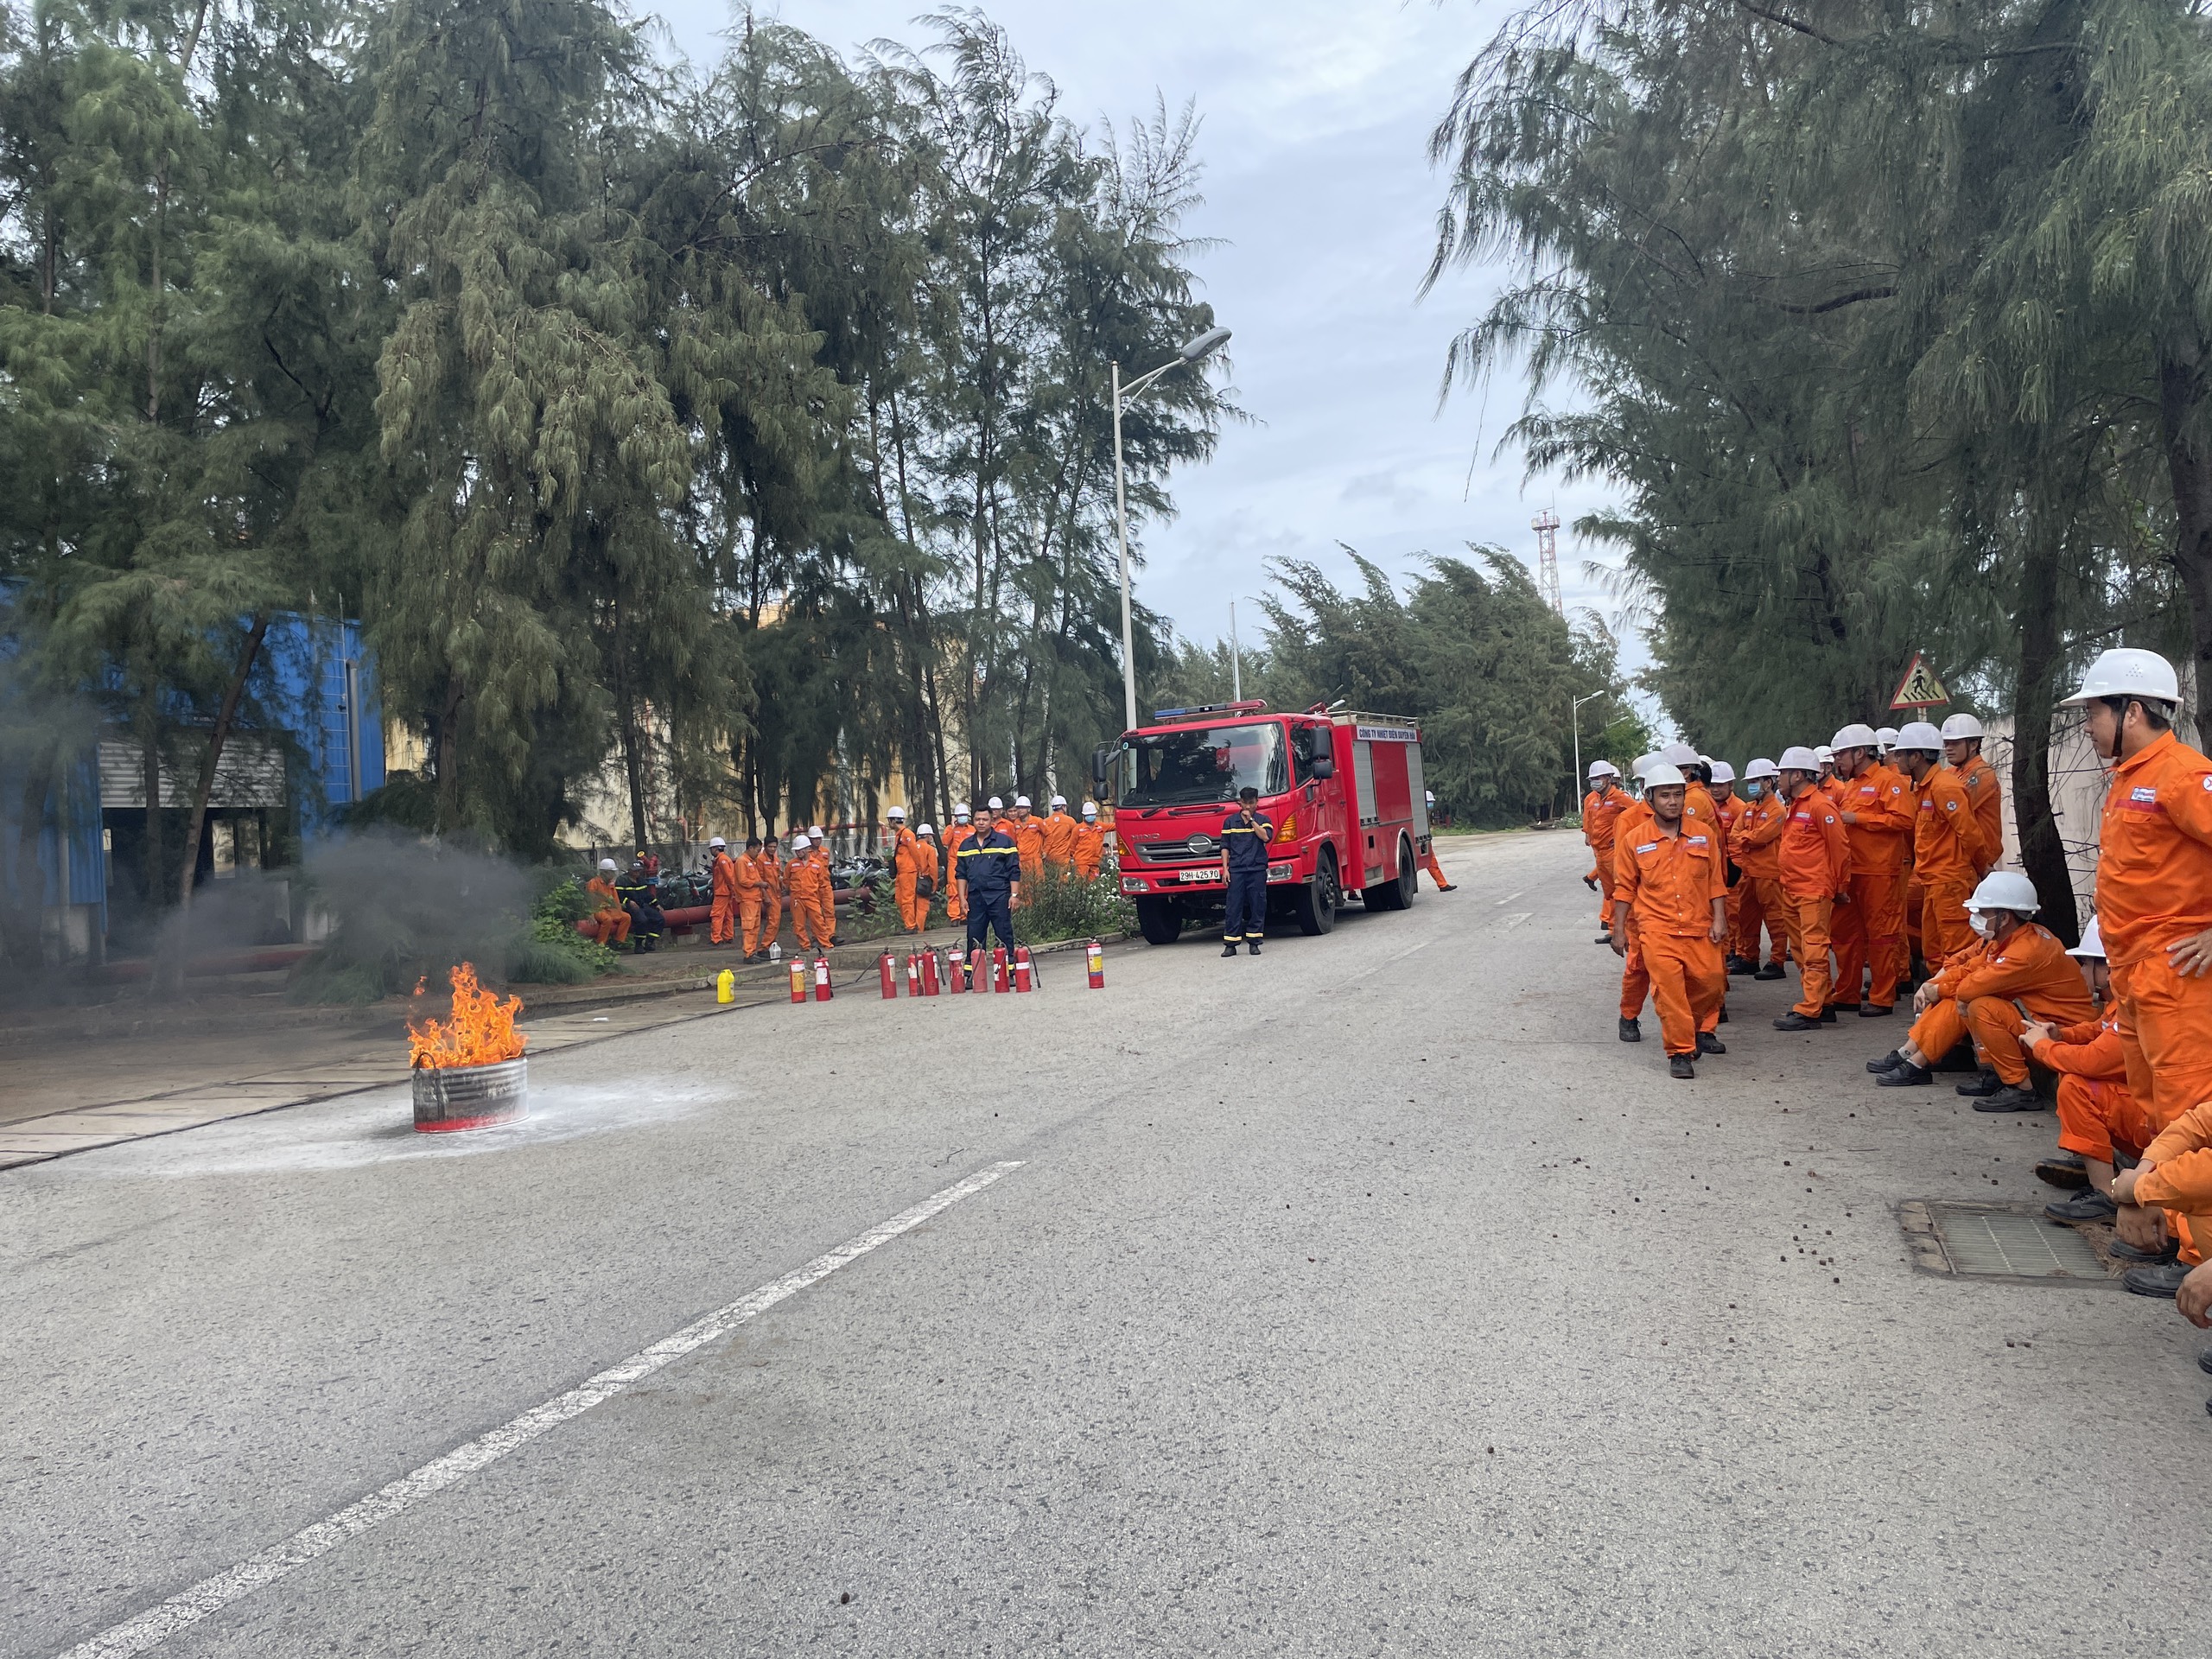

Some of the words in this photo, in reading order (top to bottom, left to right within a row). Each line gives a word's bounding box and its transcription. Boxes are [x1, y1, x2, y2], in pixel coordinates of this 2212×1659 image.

[1359, 728, 1370, 738] CÔNG
[1371, 729, 1376, 738] TY
[1131, 832, 1160, 842] HINO
